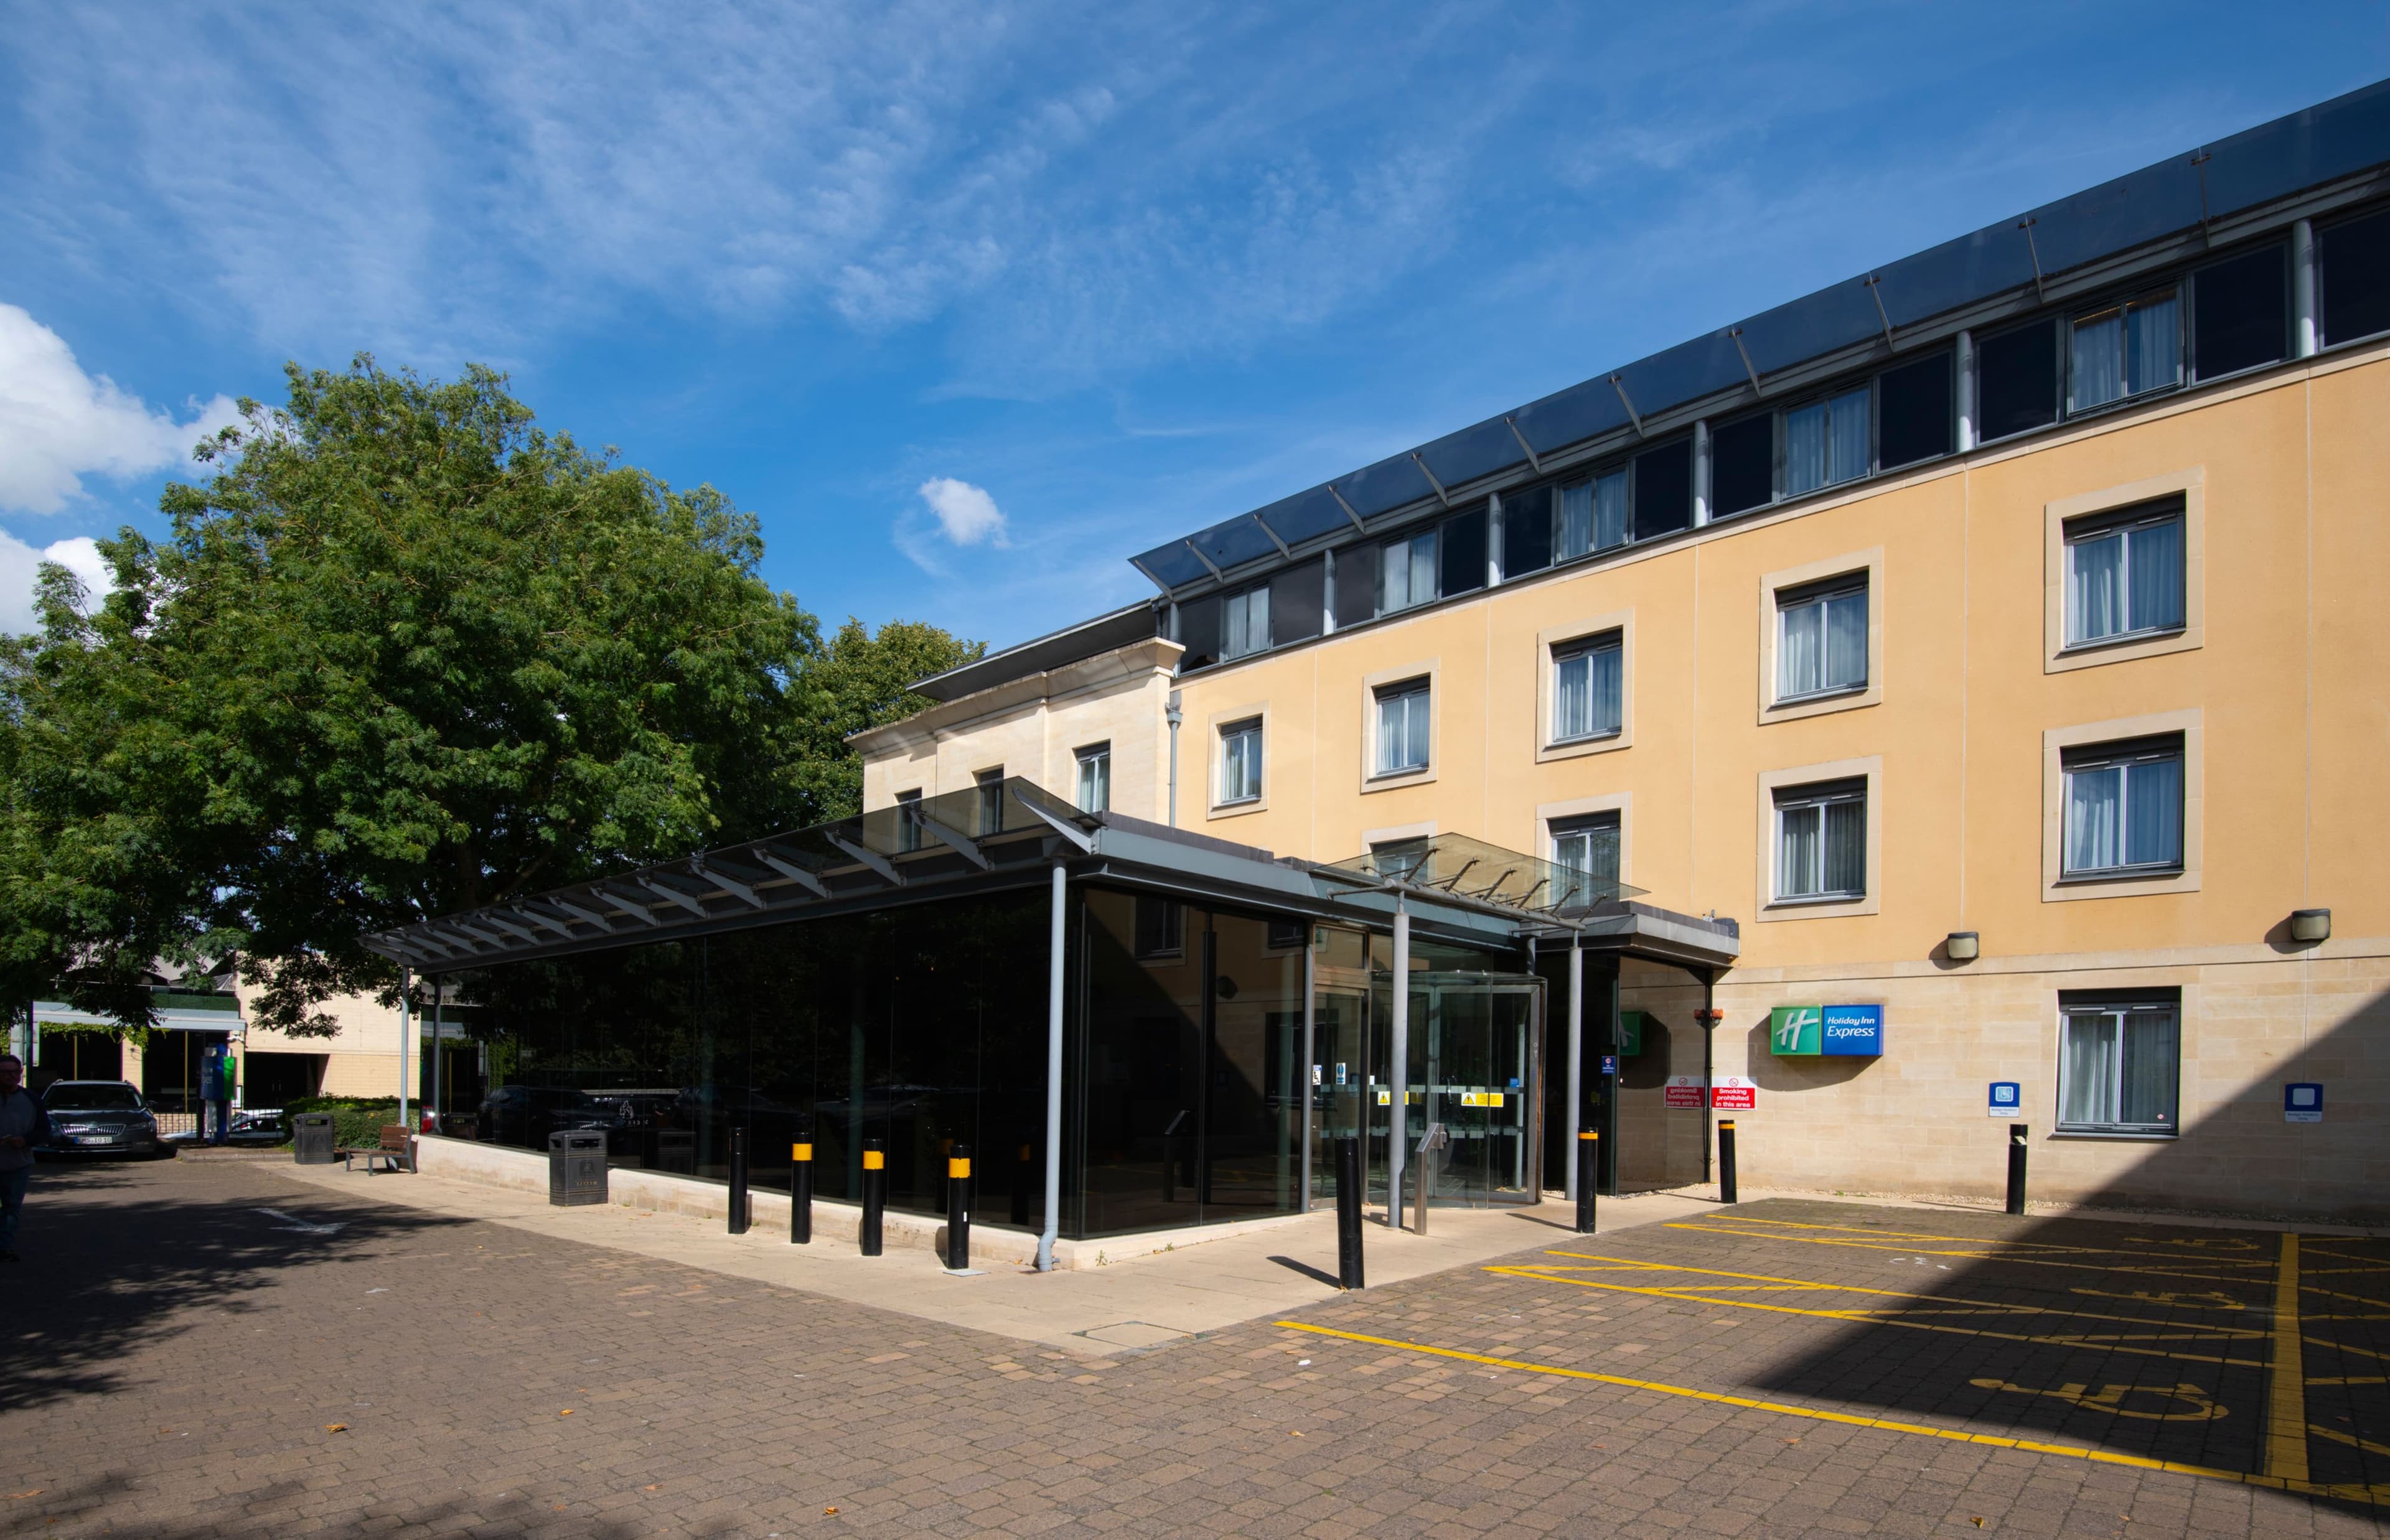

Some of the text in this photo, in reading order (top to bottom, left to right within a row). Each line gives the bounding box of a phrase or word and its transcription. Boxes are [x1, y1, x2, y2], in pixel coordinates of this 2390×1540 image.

[1827, 1016, 1875, 1026] Holiday Inn
[1776, 1009, 1819, 1050] H
[1827, 1025, 1875, 1039] Express
